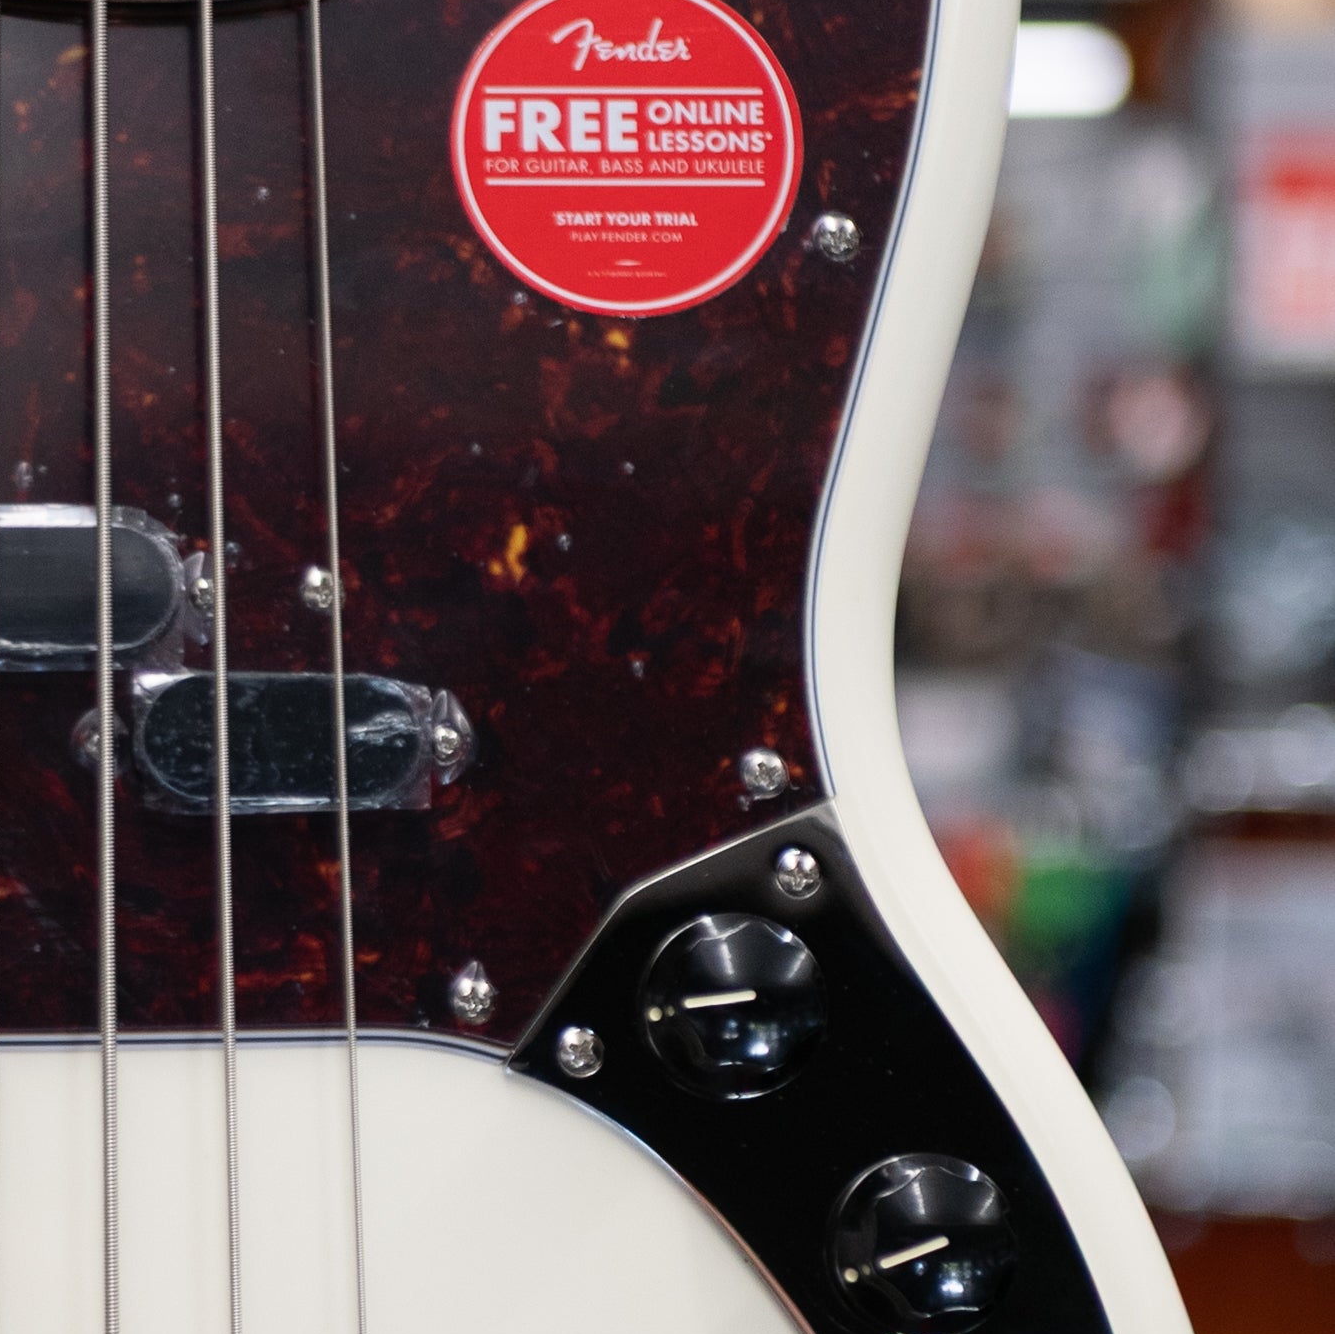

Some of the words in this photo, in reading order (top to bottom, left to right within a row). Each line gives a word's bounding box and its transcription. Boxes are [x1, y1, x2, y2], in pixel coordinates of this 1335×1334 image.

[552, 18, 691, 71] Fender
[484, 99, 639, 153] FREE
[647, 100, 764, 126] ONLINE
[486, 158, 519, 174] FOR
[526, 158, 594, 175] GUITAR,
[601, 158, 643, 174] BASS
[649, 158, 689, 174] AND
[694, 158, 765, 174] UKULELE
[555, 211, 602, 226] START
[607, 211, 651, 227] YOUR
[655, 211, 698, 227] TRIAL
